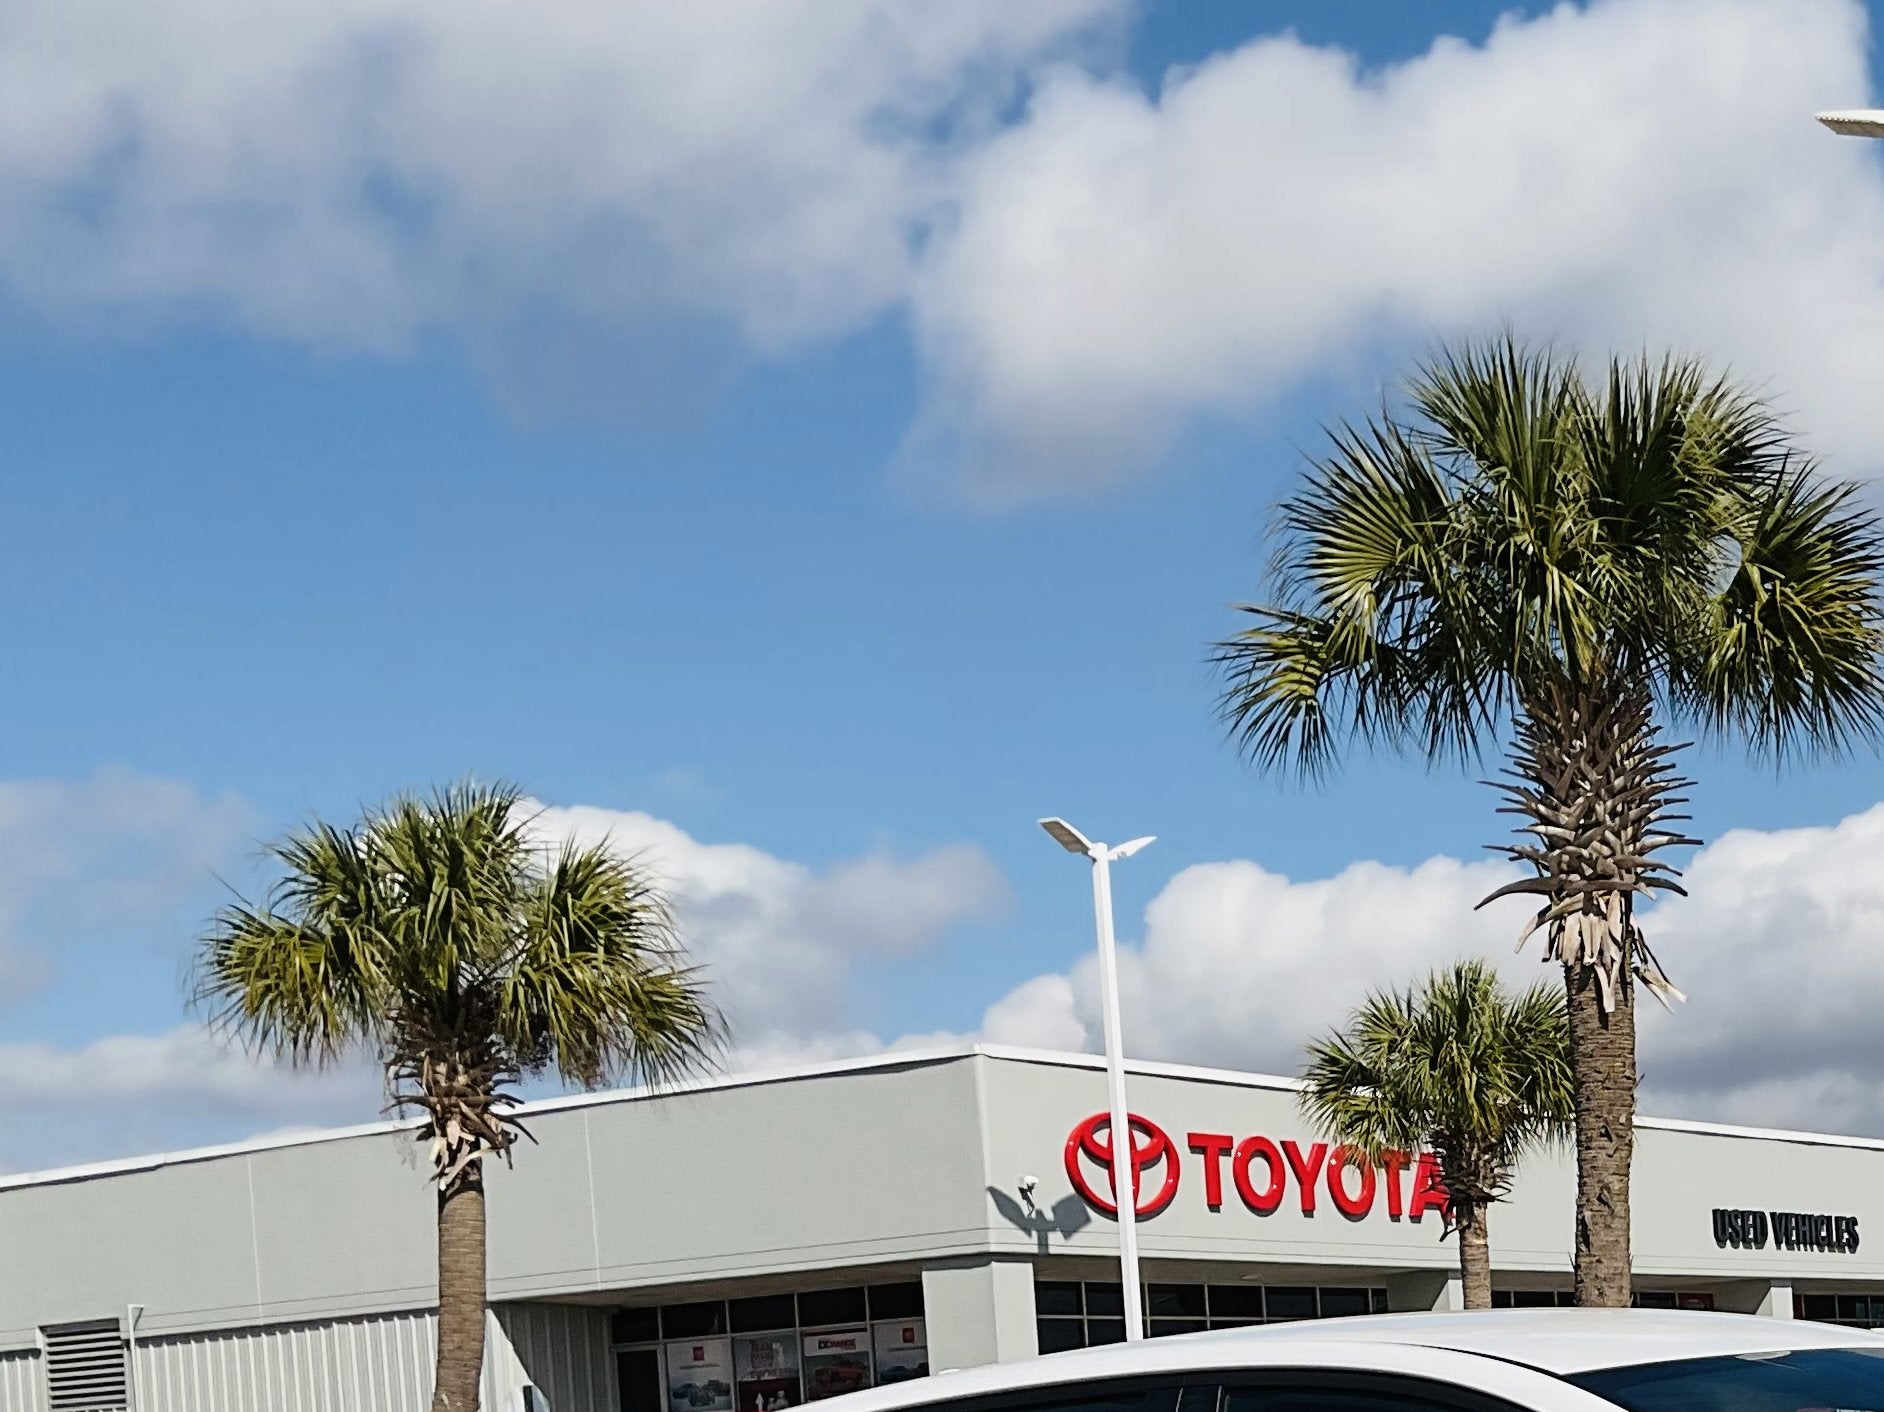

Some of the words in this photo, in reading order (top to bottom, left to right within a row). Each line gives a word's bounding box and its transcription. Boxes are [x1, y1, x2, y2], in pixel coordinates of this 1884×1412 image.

[1187, 1131, 1457, 1220] TOYOTA
[1712, 1208, 1768, 1248] USED
[1770, 1211, 1859, 1253] VEHICLES
